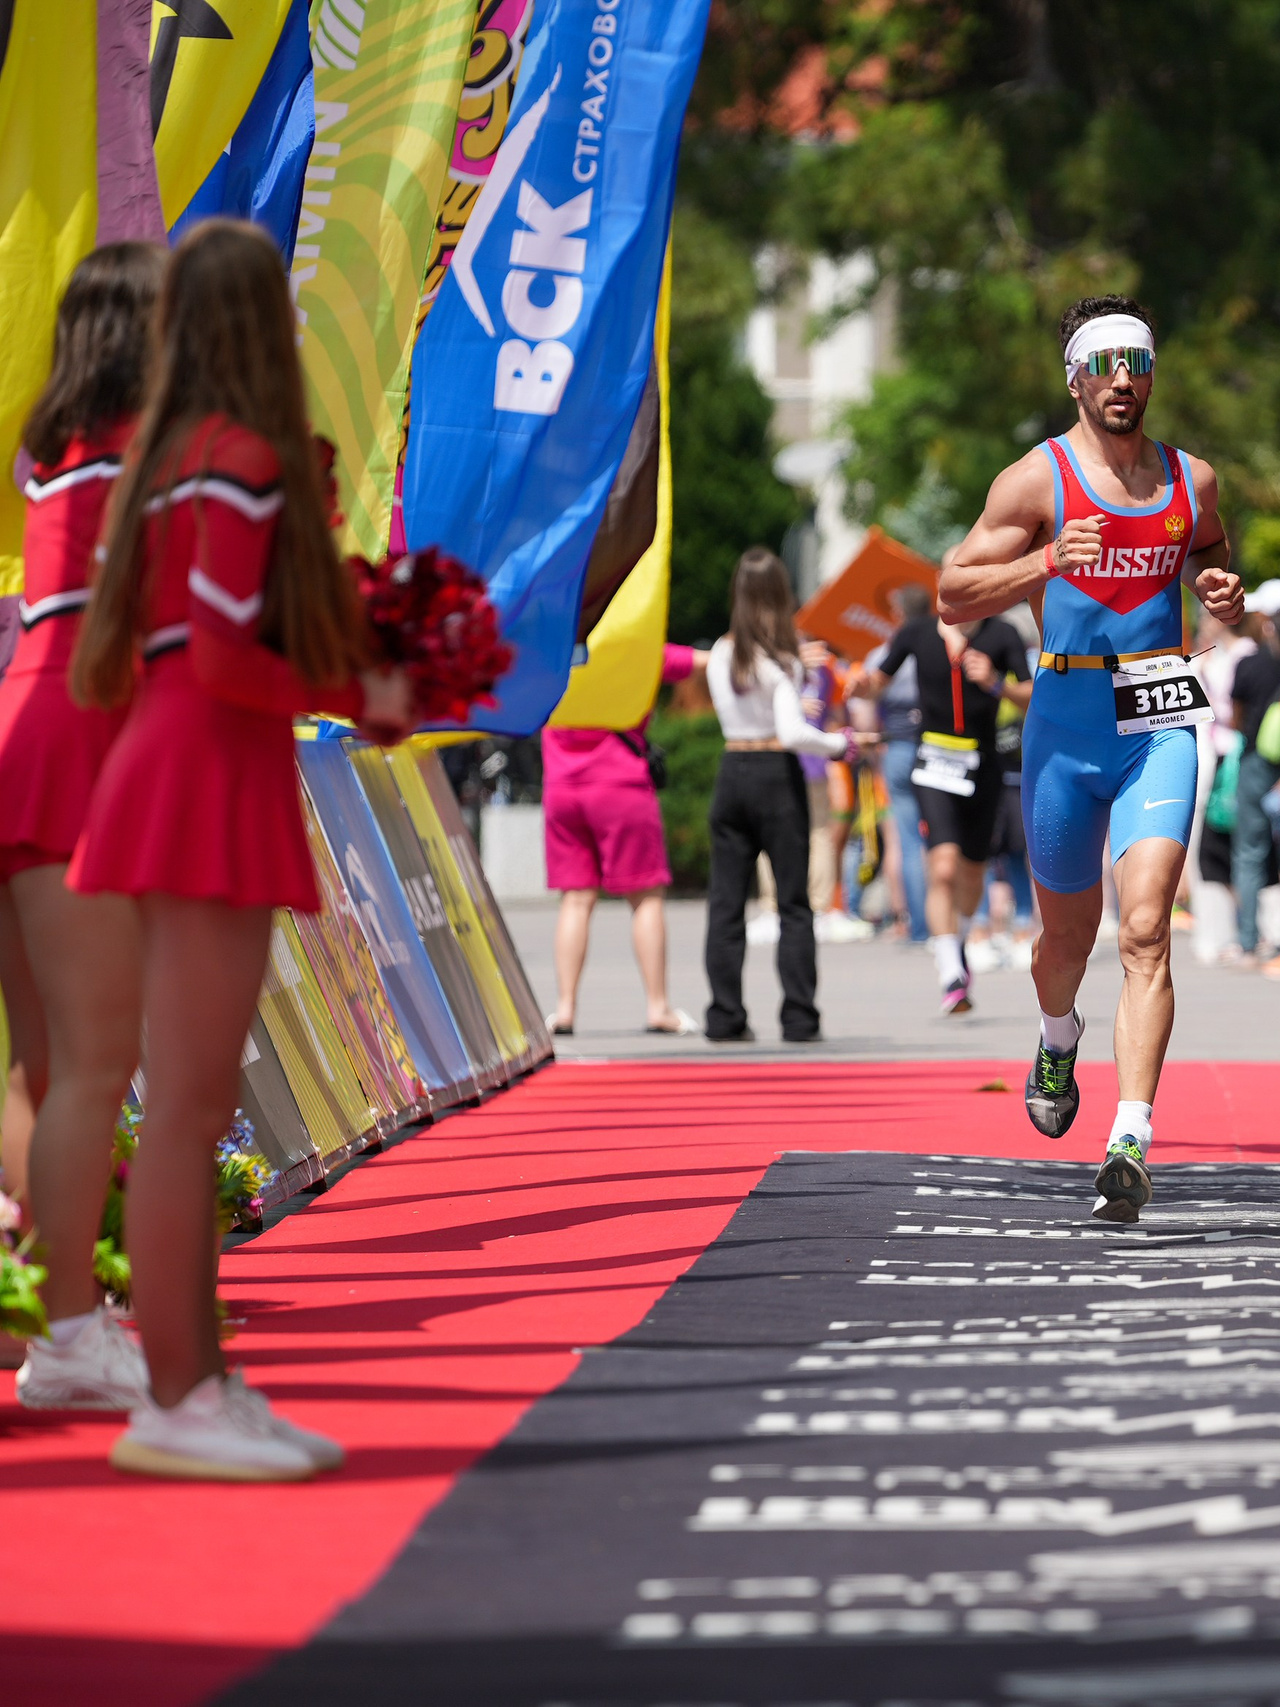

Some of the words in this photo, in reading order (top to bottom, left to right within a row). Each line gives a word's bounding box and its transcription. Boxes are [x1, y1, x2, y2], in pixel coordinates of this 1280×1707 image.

[493, 178, 594, 416] ВСК
[1134, 680, 1194, 714] 3125
[1149, 714, 1185, 726] MAGOMED
